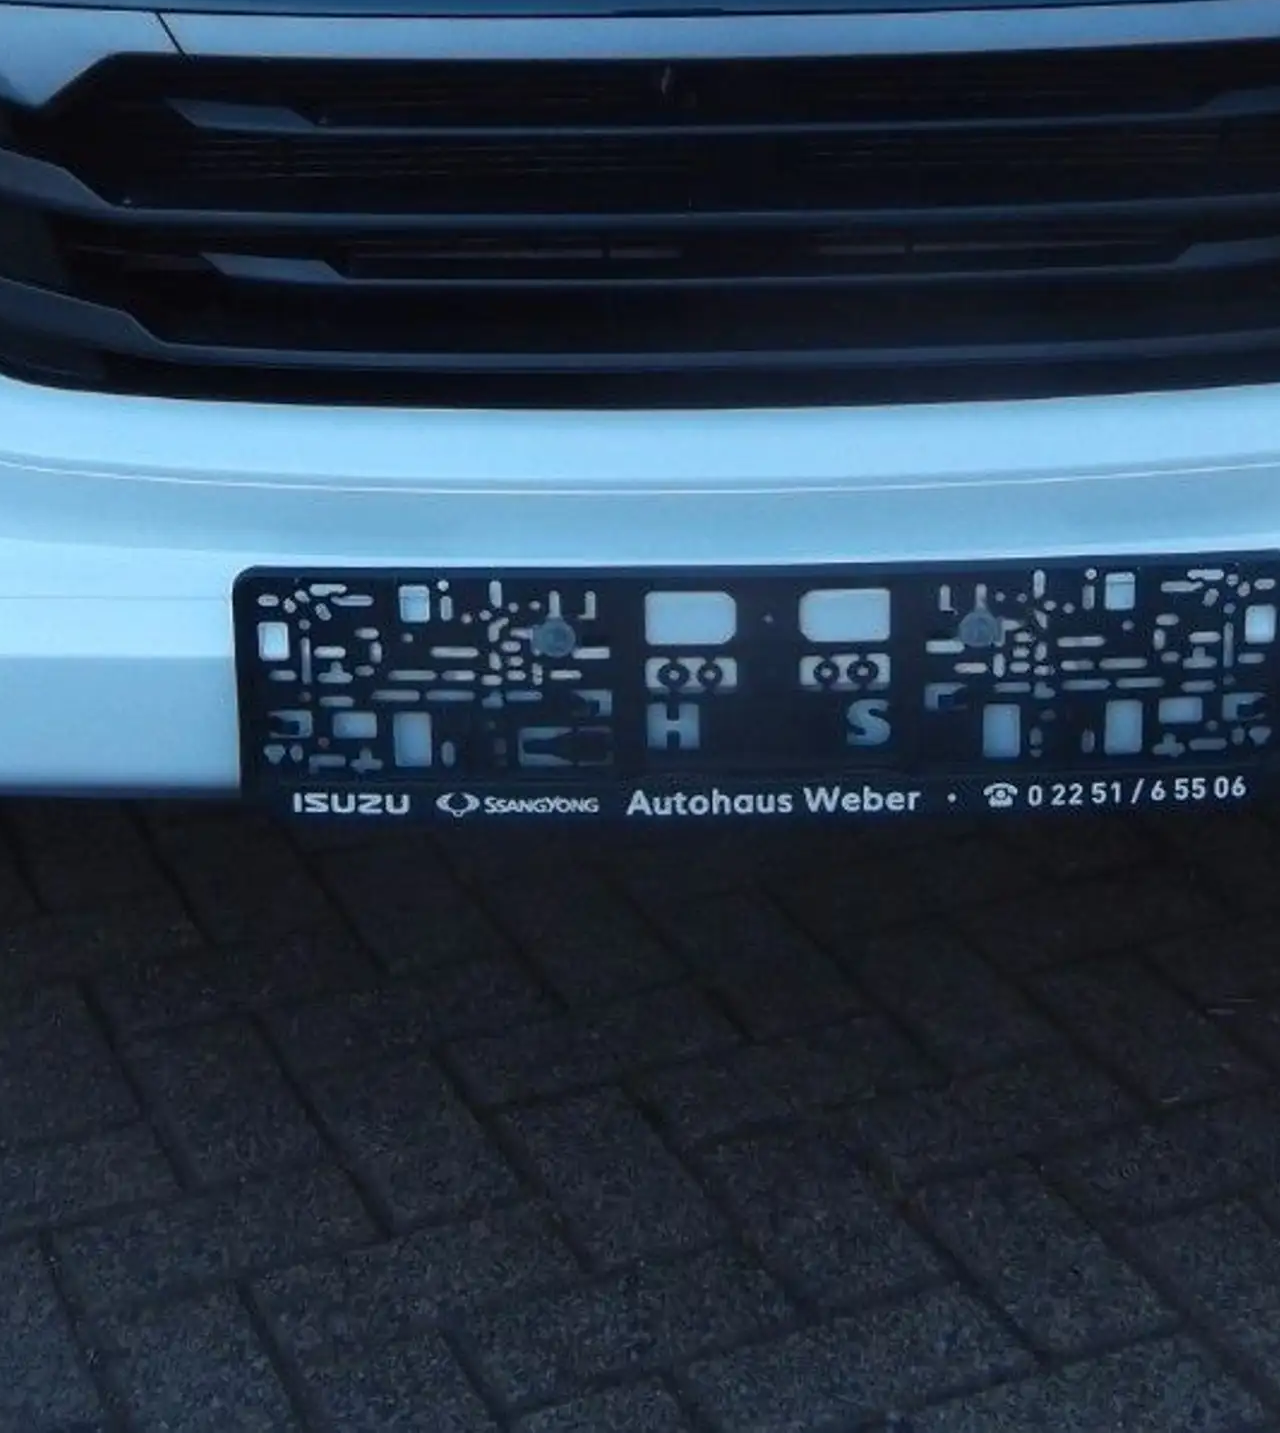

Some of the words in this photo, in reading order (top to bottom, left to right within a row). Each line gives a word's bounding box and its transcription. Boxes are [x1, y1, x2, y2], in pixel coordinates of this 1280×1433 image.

[292, 792, 411, 815] ISUZU
[626, 787, 794, 816] Autohaus
[803, 784, 922, 813] Weber
